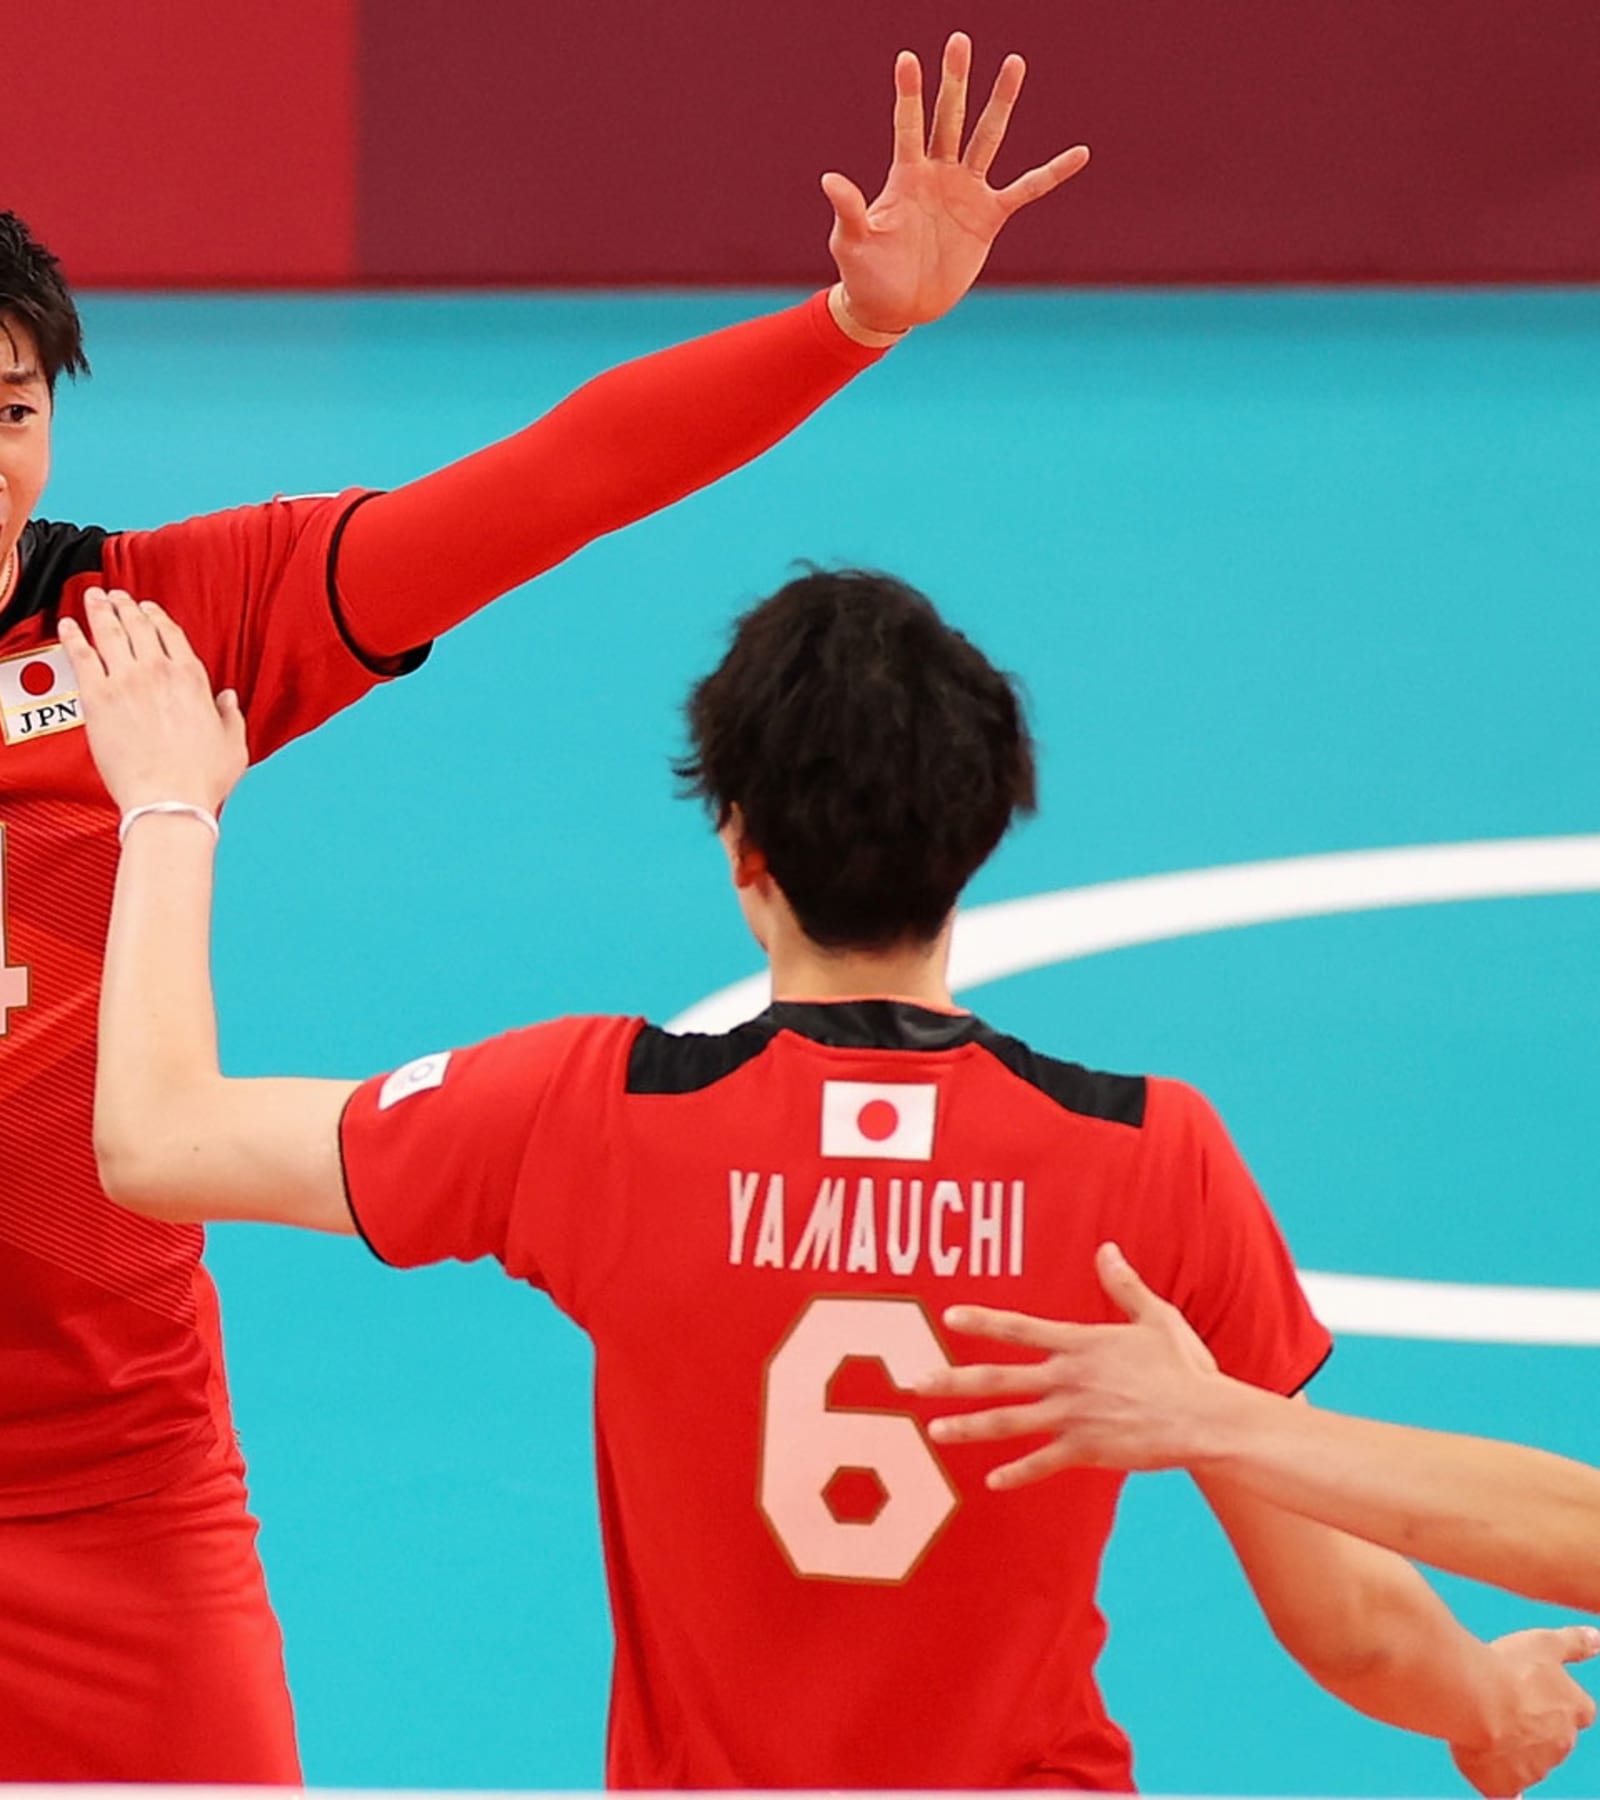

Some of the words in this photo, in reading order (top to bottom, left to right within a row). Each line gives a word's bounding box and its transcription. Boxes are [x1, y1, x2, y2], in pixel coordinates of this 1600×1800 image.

[19, 698, 78, 734] JPN
[728, 1169, 1025, 1278] YAMAUCHI
[756, 1292, 962, 1586] 6
